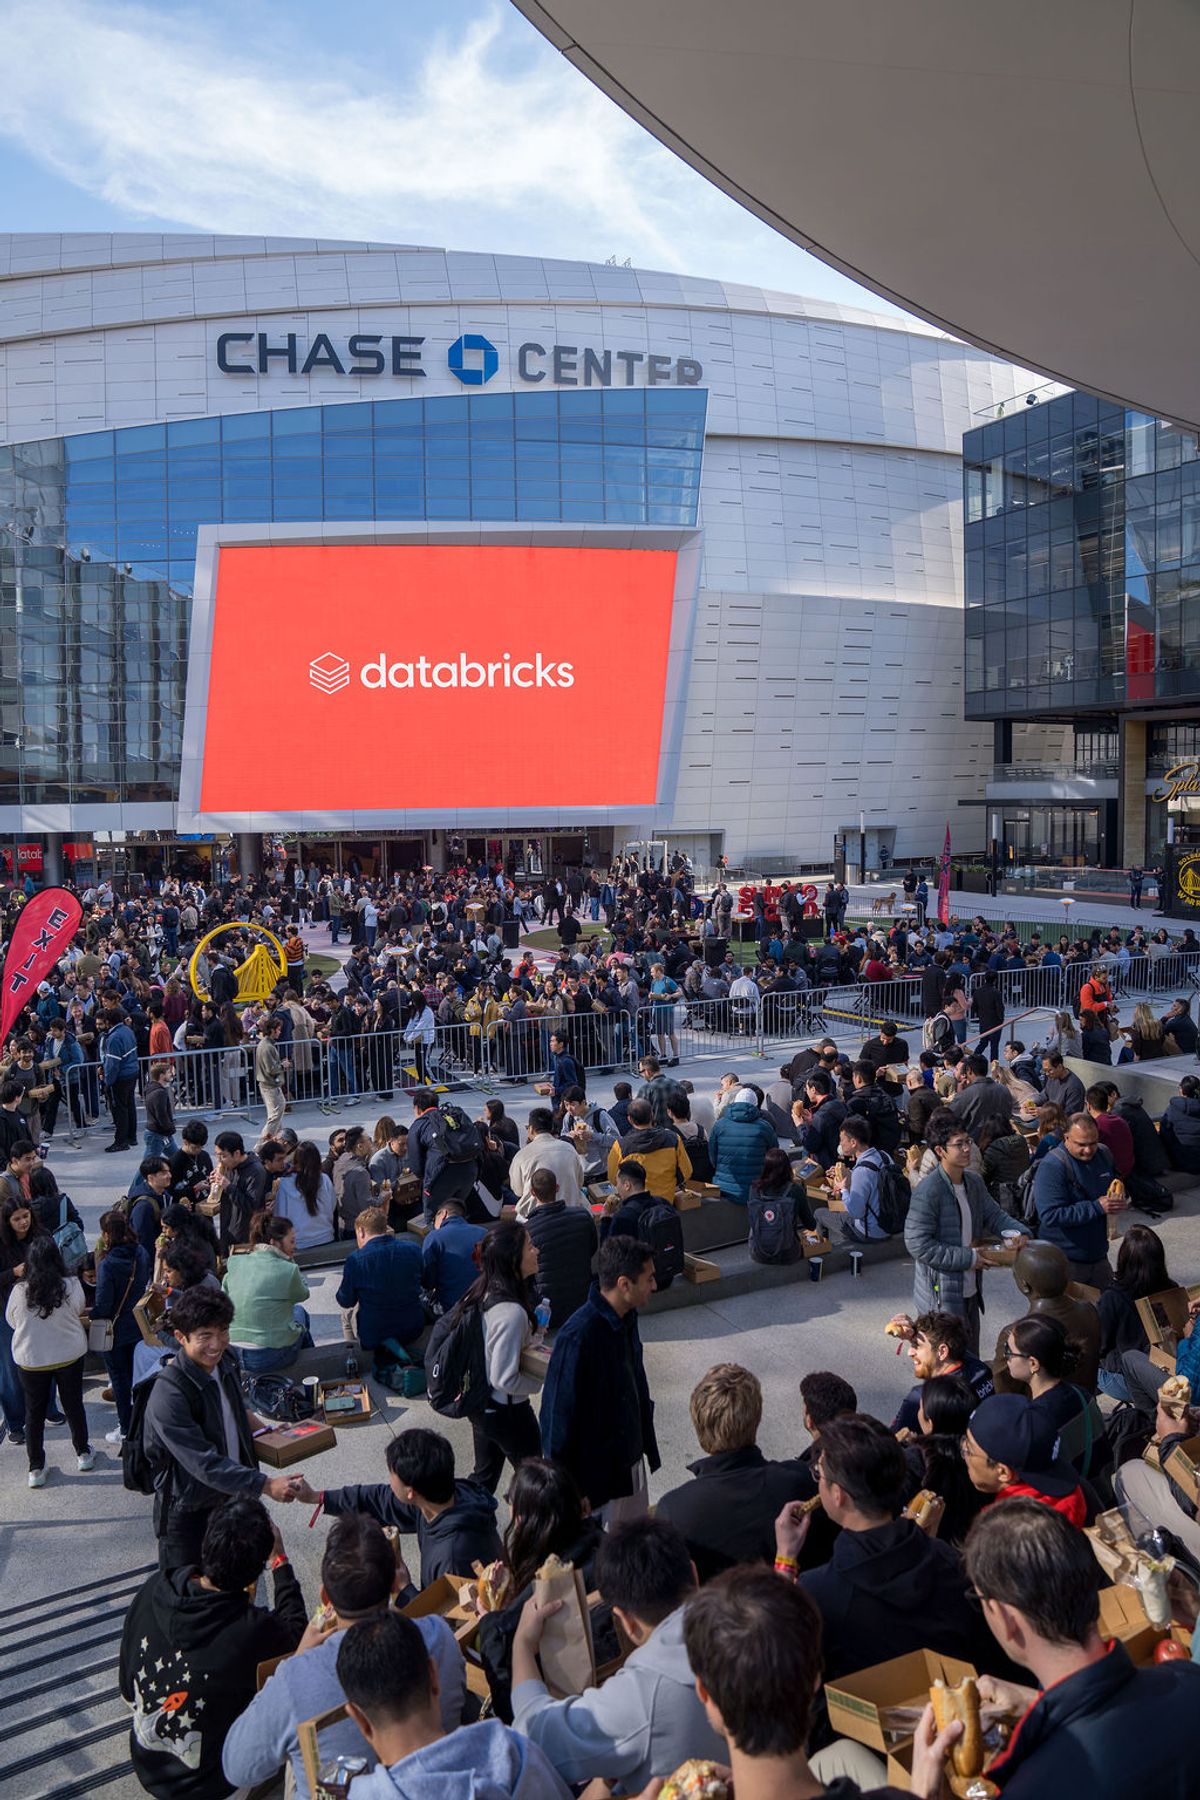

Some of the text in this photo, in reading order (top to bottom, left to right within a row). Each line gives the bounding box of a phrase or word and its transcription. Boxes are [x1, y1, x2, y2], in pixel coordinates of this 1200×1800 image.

[217, 333, 703, 386] CHASE CENTER
[360, 652, 575, 688] databricks
[10, 907, 69, 993] EXIT
